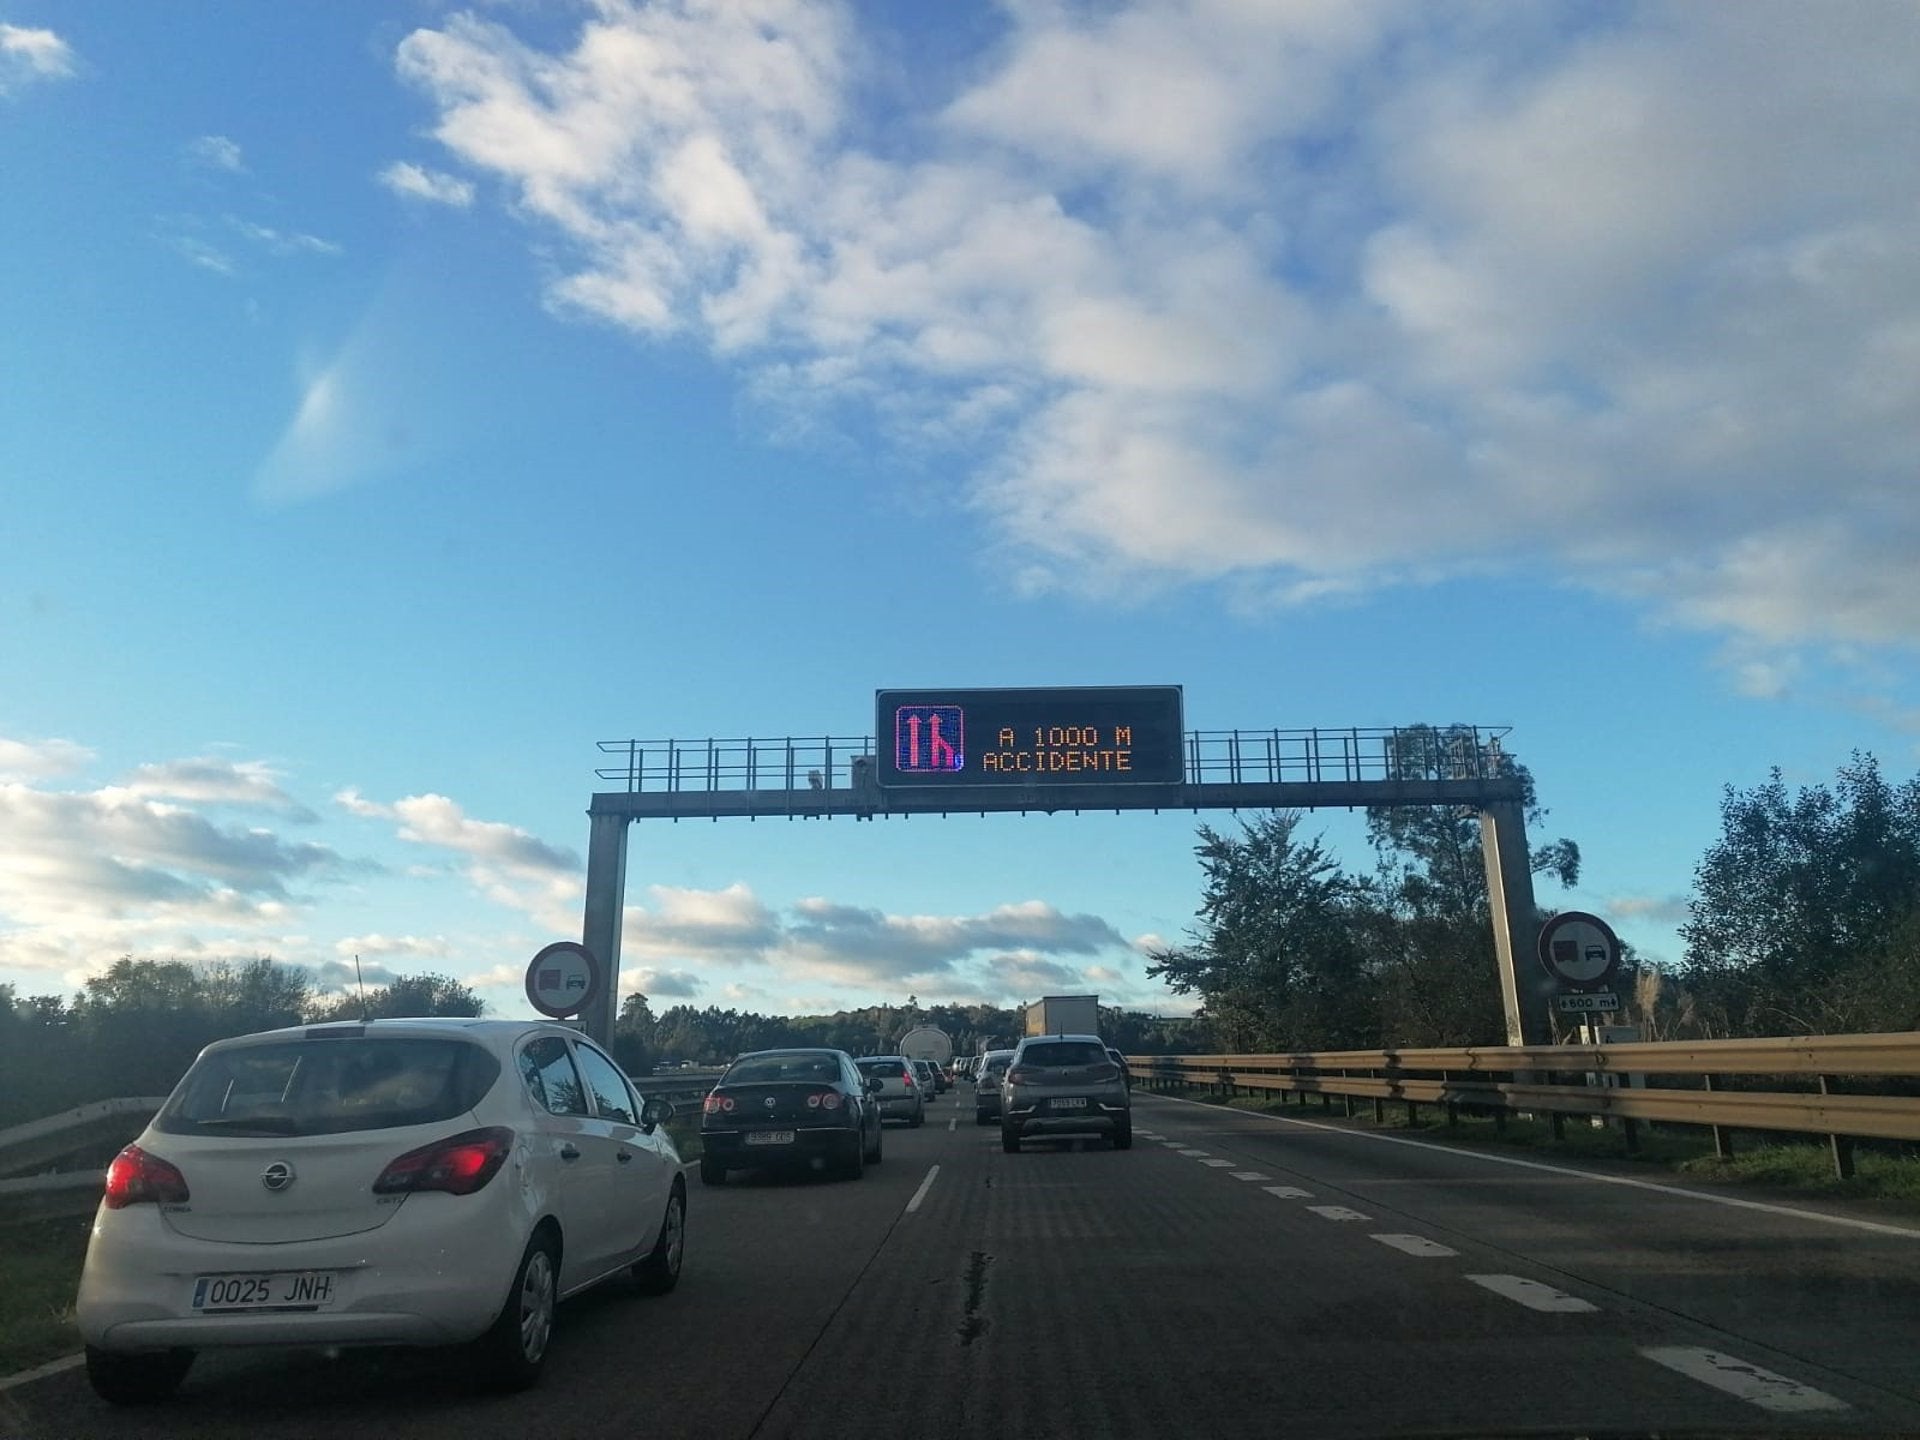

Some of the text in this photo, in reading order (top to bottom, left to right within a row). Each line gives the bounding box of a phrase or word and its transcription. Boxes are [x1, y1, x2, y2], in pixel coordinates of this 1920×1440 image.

[1000, 726, 1131, 747] A 1000 M
[983, 750, 1132, 771] ACCIDENTE
[210, 1276, 330, 1304] 0025 JNH
